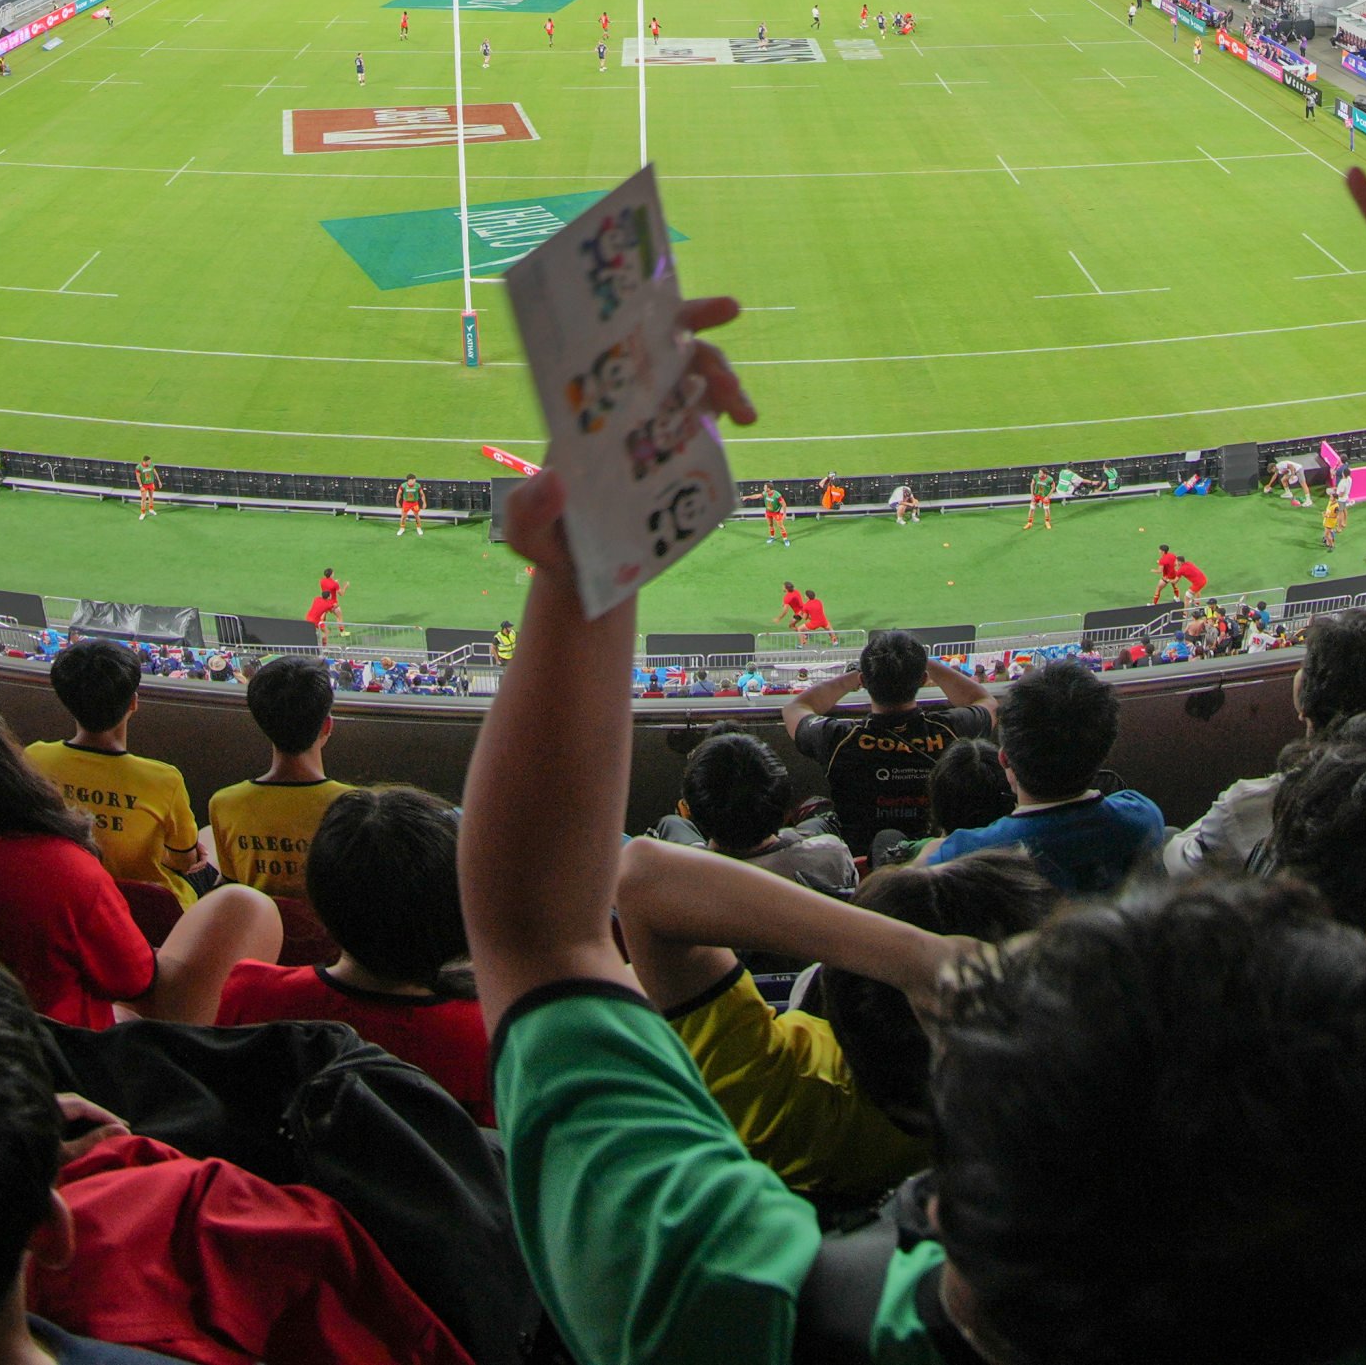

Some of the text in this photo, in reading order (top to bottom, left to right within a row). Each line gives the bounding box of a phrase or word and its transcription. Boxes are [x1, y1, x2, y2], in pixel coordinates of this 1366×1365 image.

[858, 732, 944, 754] COACH
[64, 784, 138, 810] EGORY
[238, 835, 309, 853] GREGO
[256, 859, 299, 876] HOU
